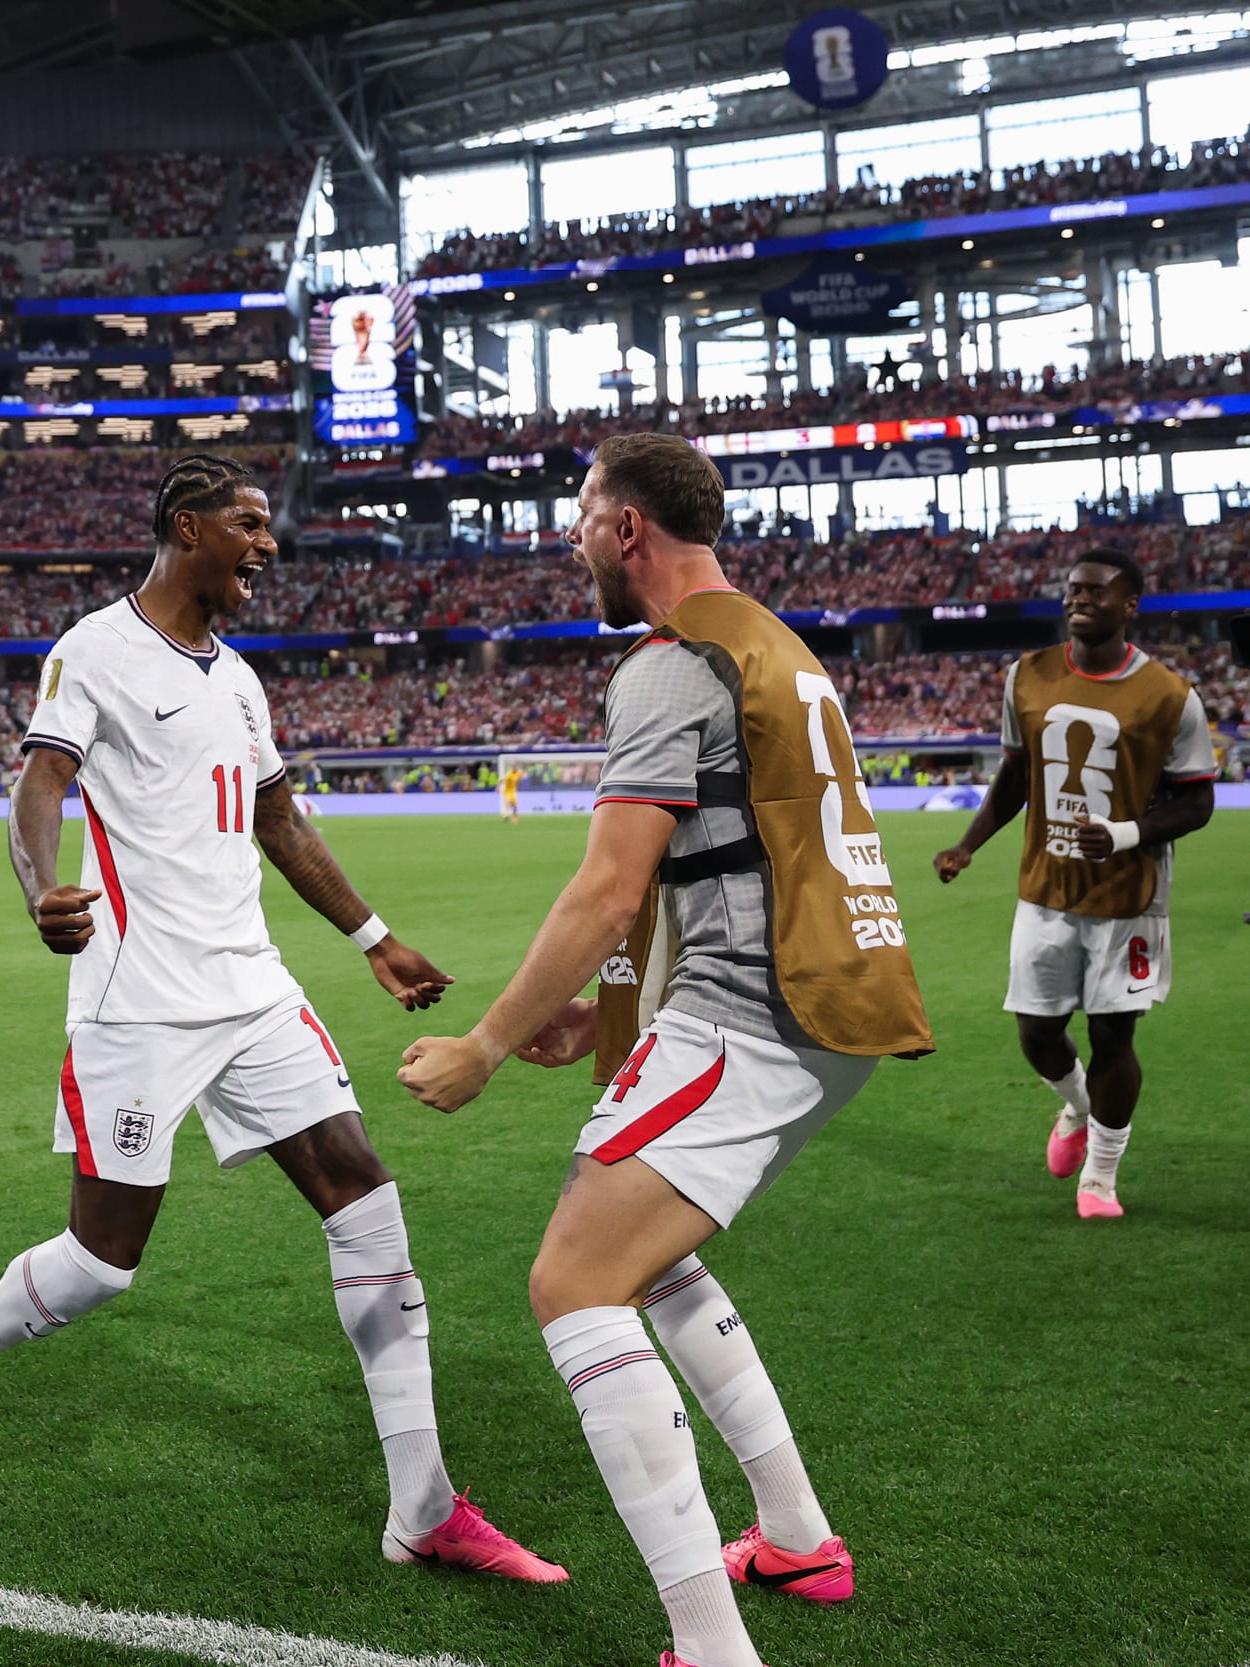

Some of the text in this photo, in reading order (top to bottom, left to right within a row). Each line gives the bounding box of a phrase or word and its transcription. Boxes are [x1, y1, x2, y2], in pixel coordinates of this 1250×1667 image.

[819, 271, 856, 288] FIFA
[331, 420, 400, 441] DALLAS
[730, 448, 954, 488] DALLAS
[212, 764, 244, 833] 11
[1056, 798, 1089, 815] FIFA
[842, 896, 898, 915] WORLD
[1129, 936, 1150, 980] 6
[611, 1032, 658, 1104] 4
